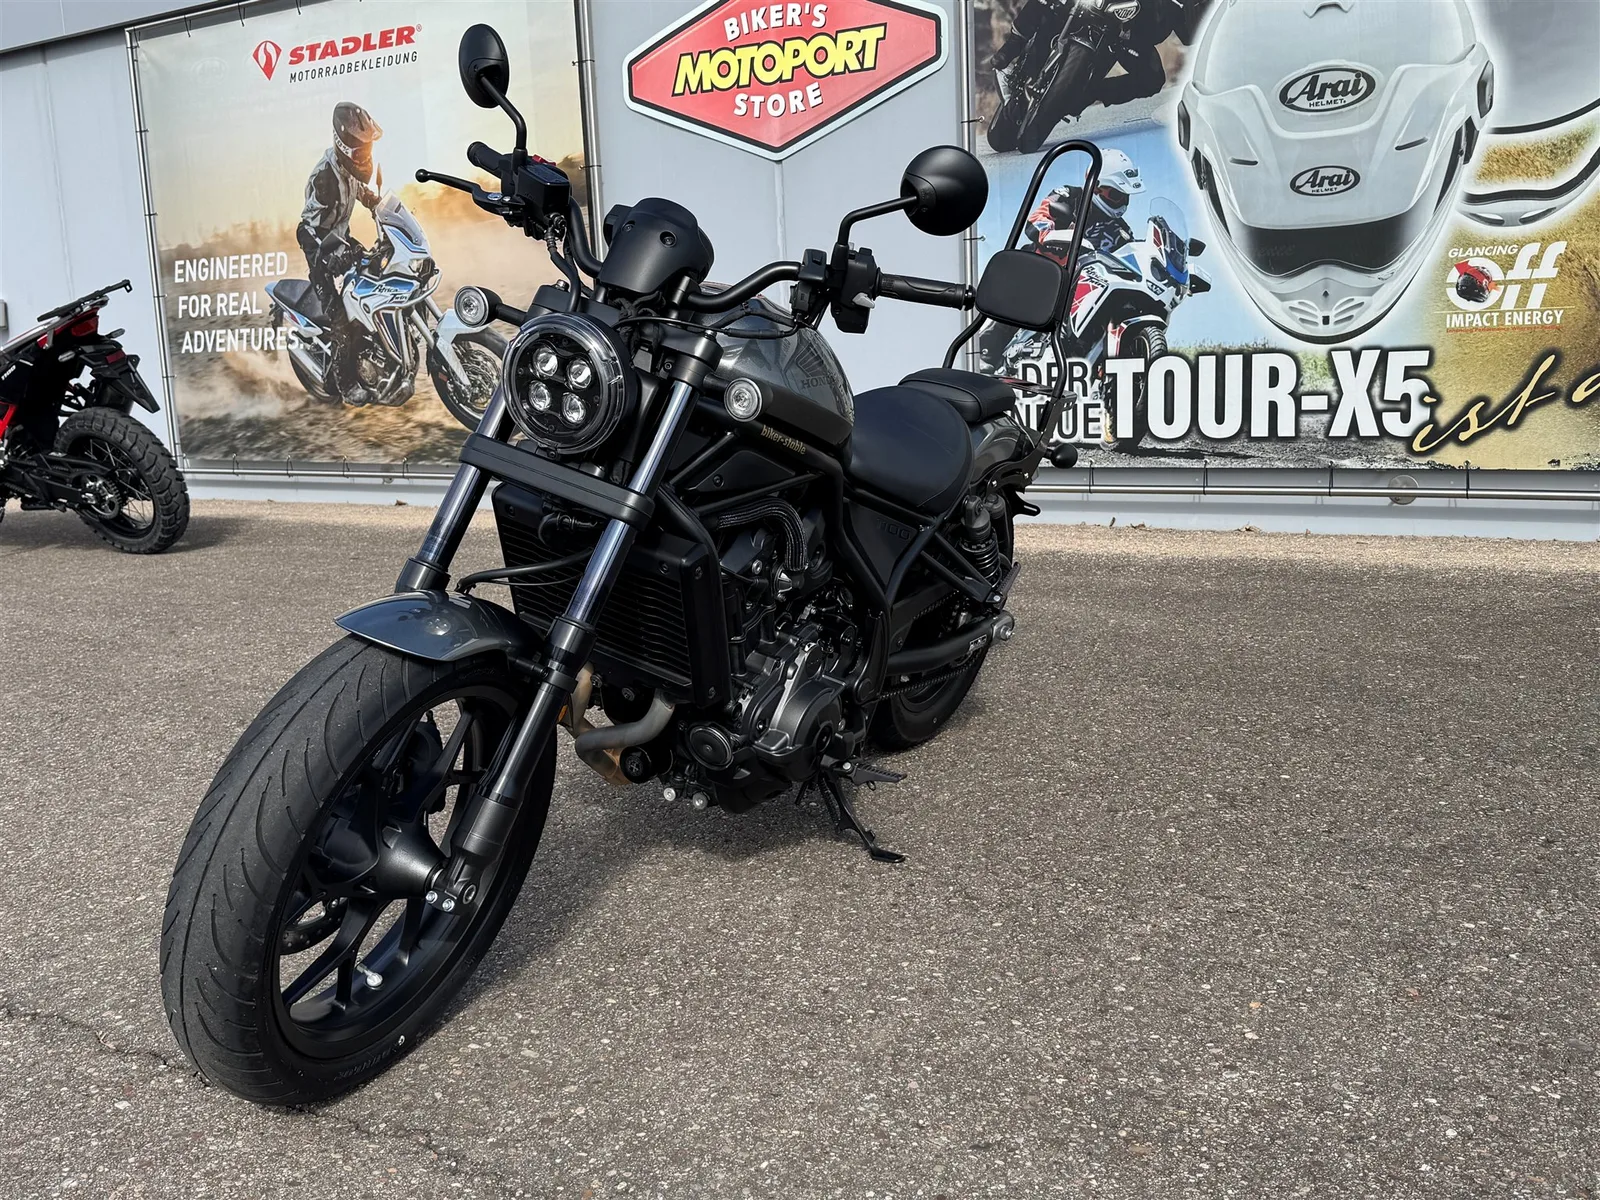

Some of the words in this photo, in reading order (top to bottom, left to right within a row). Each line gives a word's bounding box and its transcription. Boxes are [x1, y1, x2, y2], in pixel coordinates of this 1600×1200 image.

[724, 3, 828, 42] BIKER'S
[289, 51, 418, 83] MOTORRADBEKLEIDUNG
[672, 22, 887, 97] MOTOPORT
[734, 82, 824, 119] STORE
[1285, 72, 1364, 105] Arai
[1295, 169, 1352, 190] Arai
[174, 251, 288, 283] ENGINEERED
[1448, 245, 1519, 258] GLANCING
[178, 294, 211, 318] FOR
[217, 291, 262, 317] REAL
[1446, 313, 1499, 328] IMPACT
[1504, 310, 1564, 326] ENERGY
[181, 326, 304, 354] ADVENTURES.
[1105, 350, 1430, 439] TOUR-X5
[761, 425, 807, 455] biker-stable
